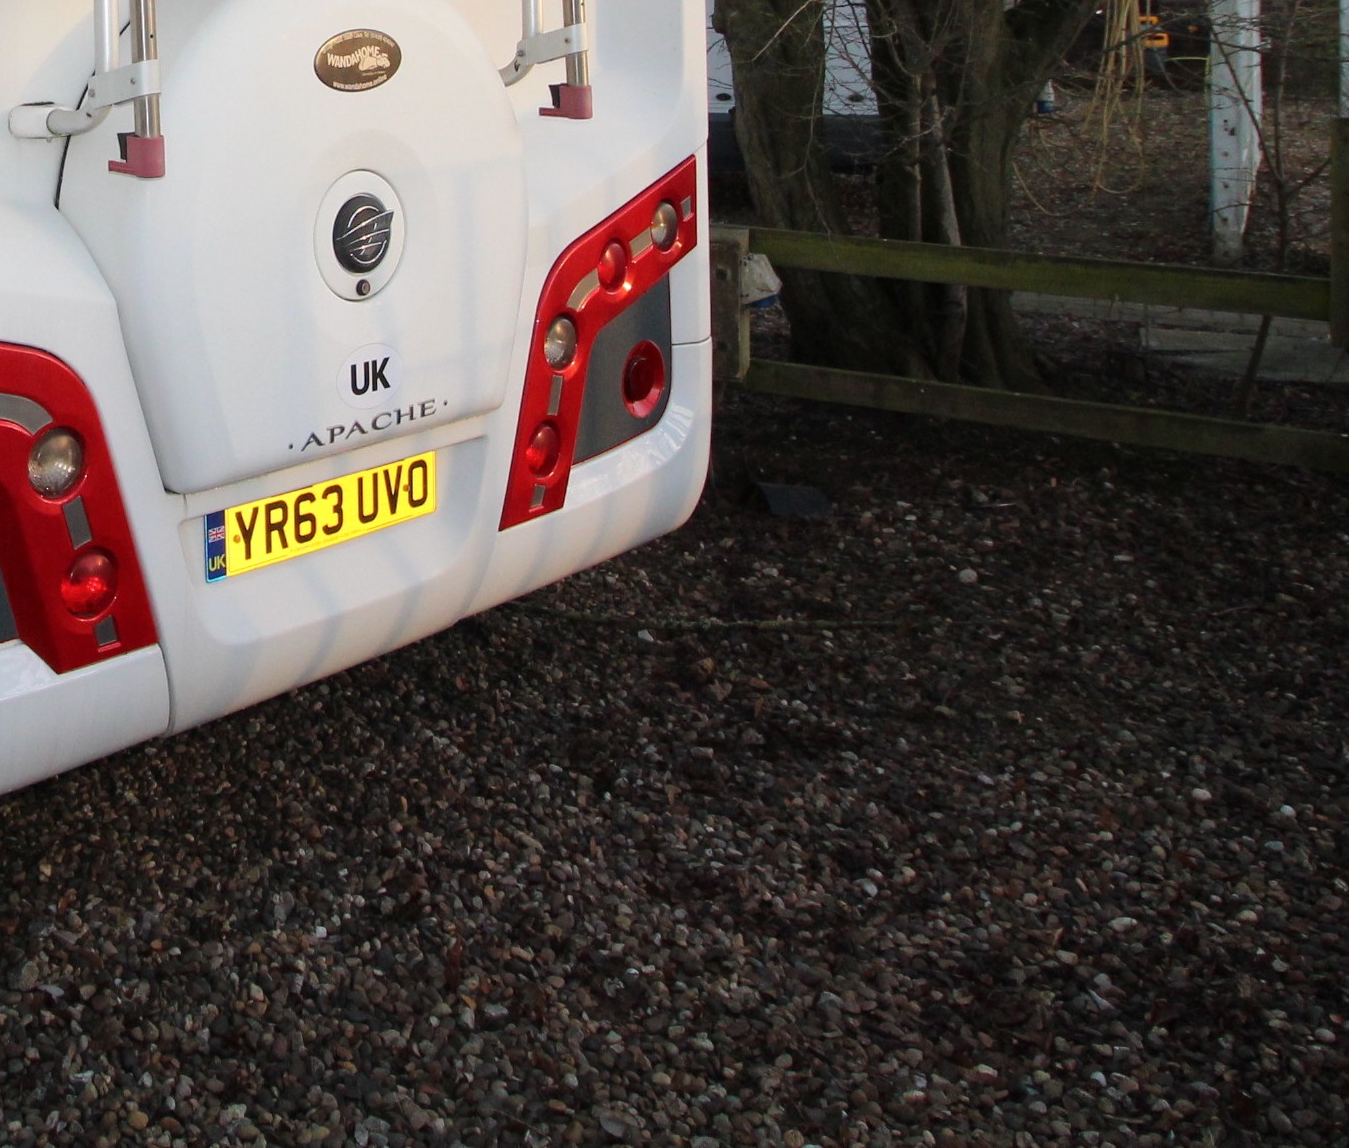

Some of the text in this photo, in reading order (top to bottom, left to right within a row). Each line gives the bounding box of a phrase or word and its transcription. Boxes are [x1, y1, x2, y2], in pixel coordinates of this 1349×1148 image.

[327, 45, 381, 68] WANDAHOME
[350, 356, 391, 396] UK
[235, 458, 428, 561] YR63 UVO
[208, 554, 227, 573] UK
